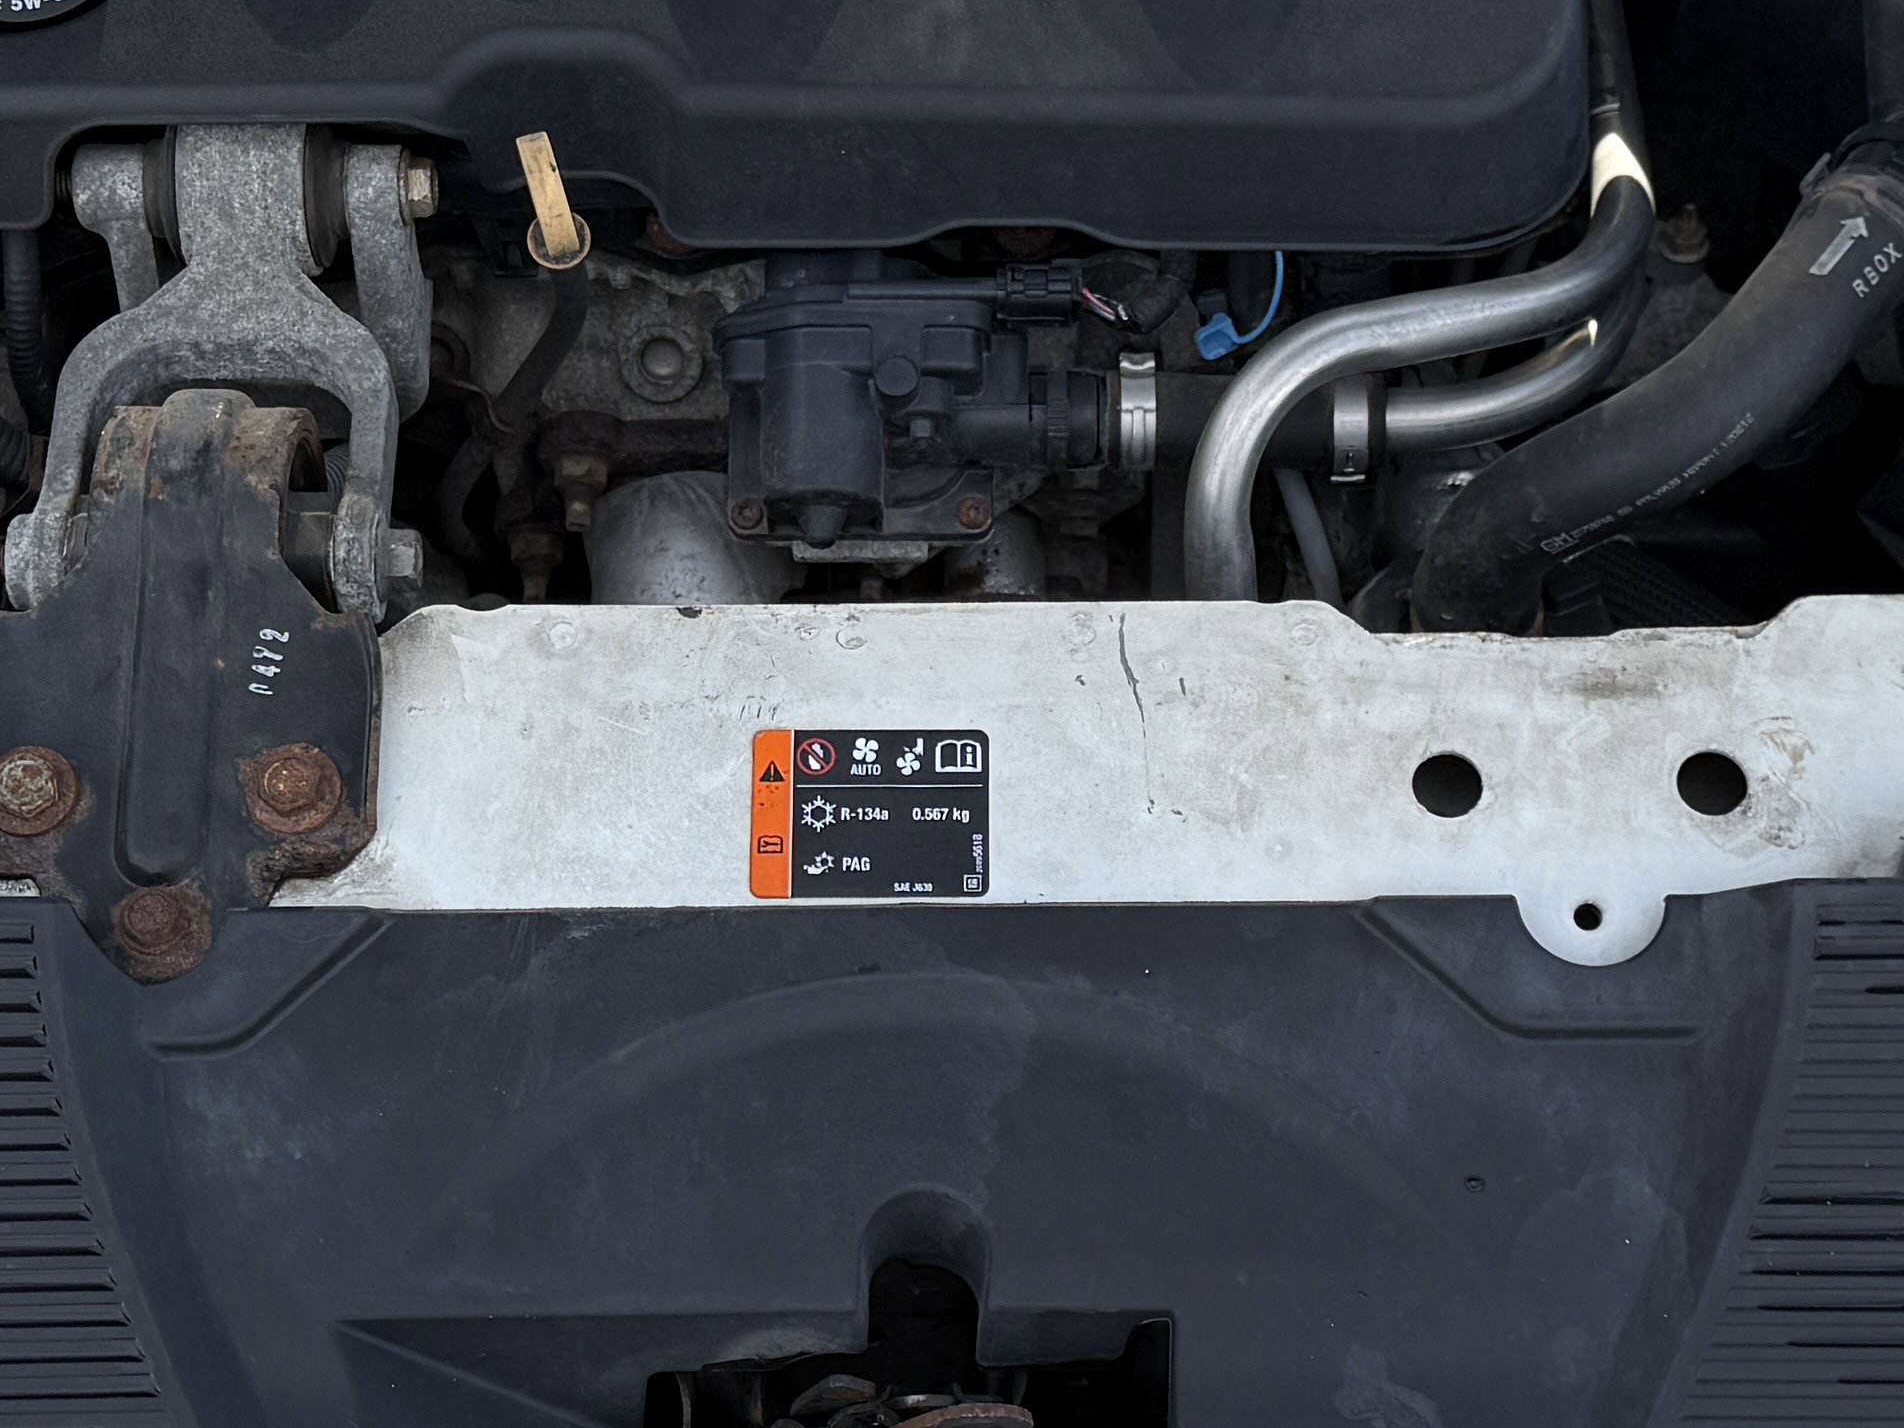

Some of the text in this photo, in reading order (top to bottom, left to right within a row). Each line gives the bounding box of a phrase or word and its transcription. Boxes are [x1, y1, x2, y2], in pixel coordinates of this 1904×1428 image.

[1852, 242, 1903, 298] RBOX
[850, 764, 882, 776] AUTO
[840, 807, 970, 823] R-134a 0.567 kg
[842, 857, 871, 871] PAG
